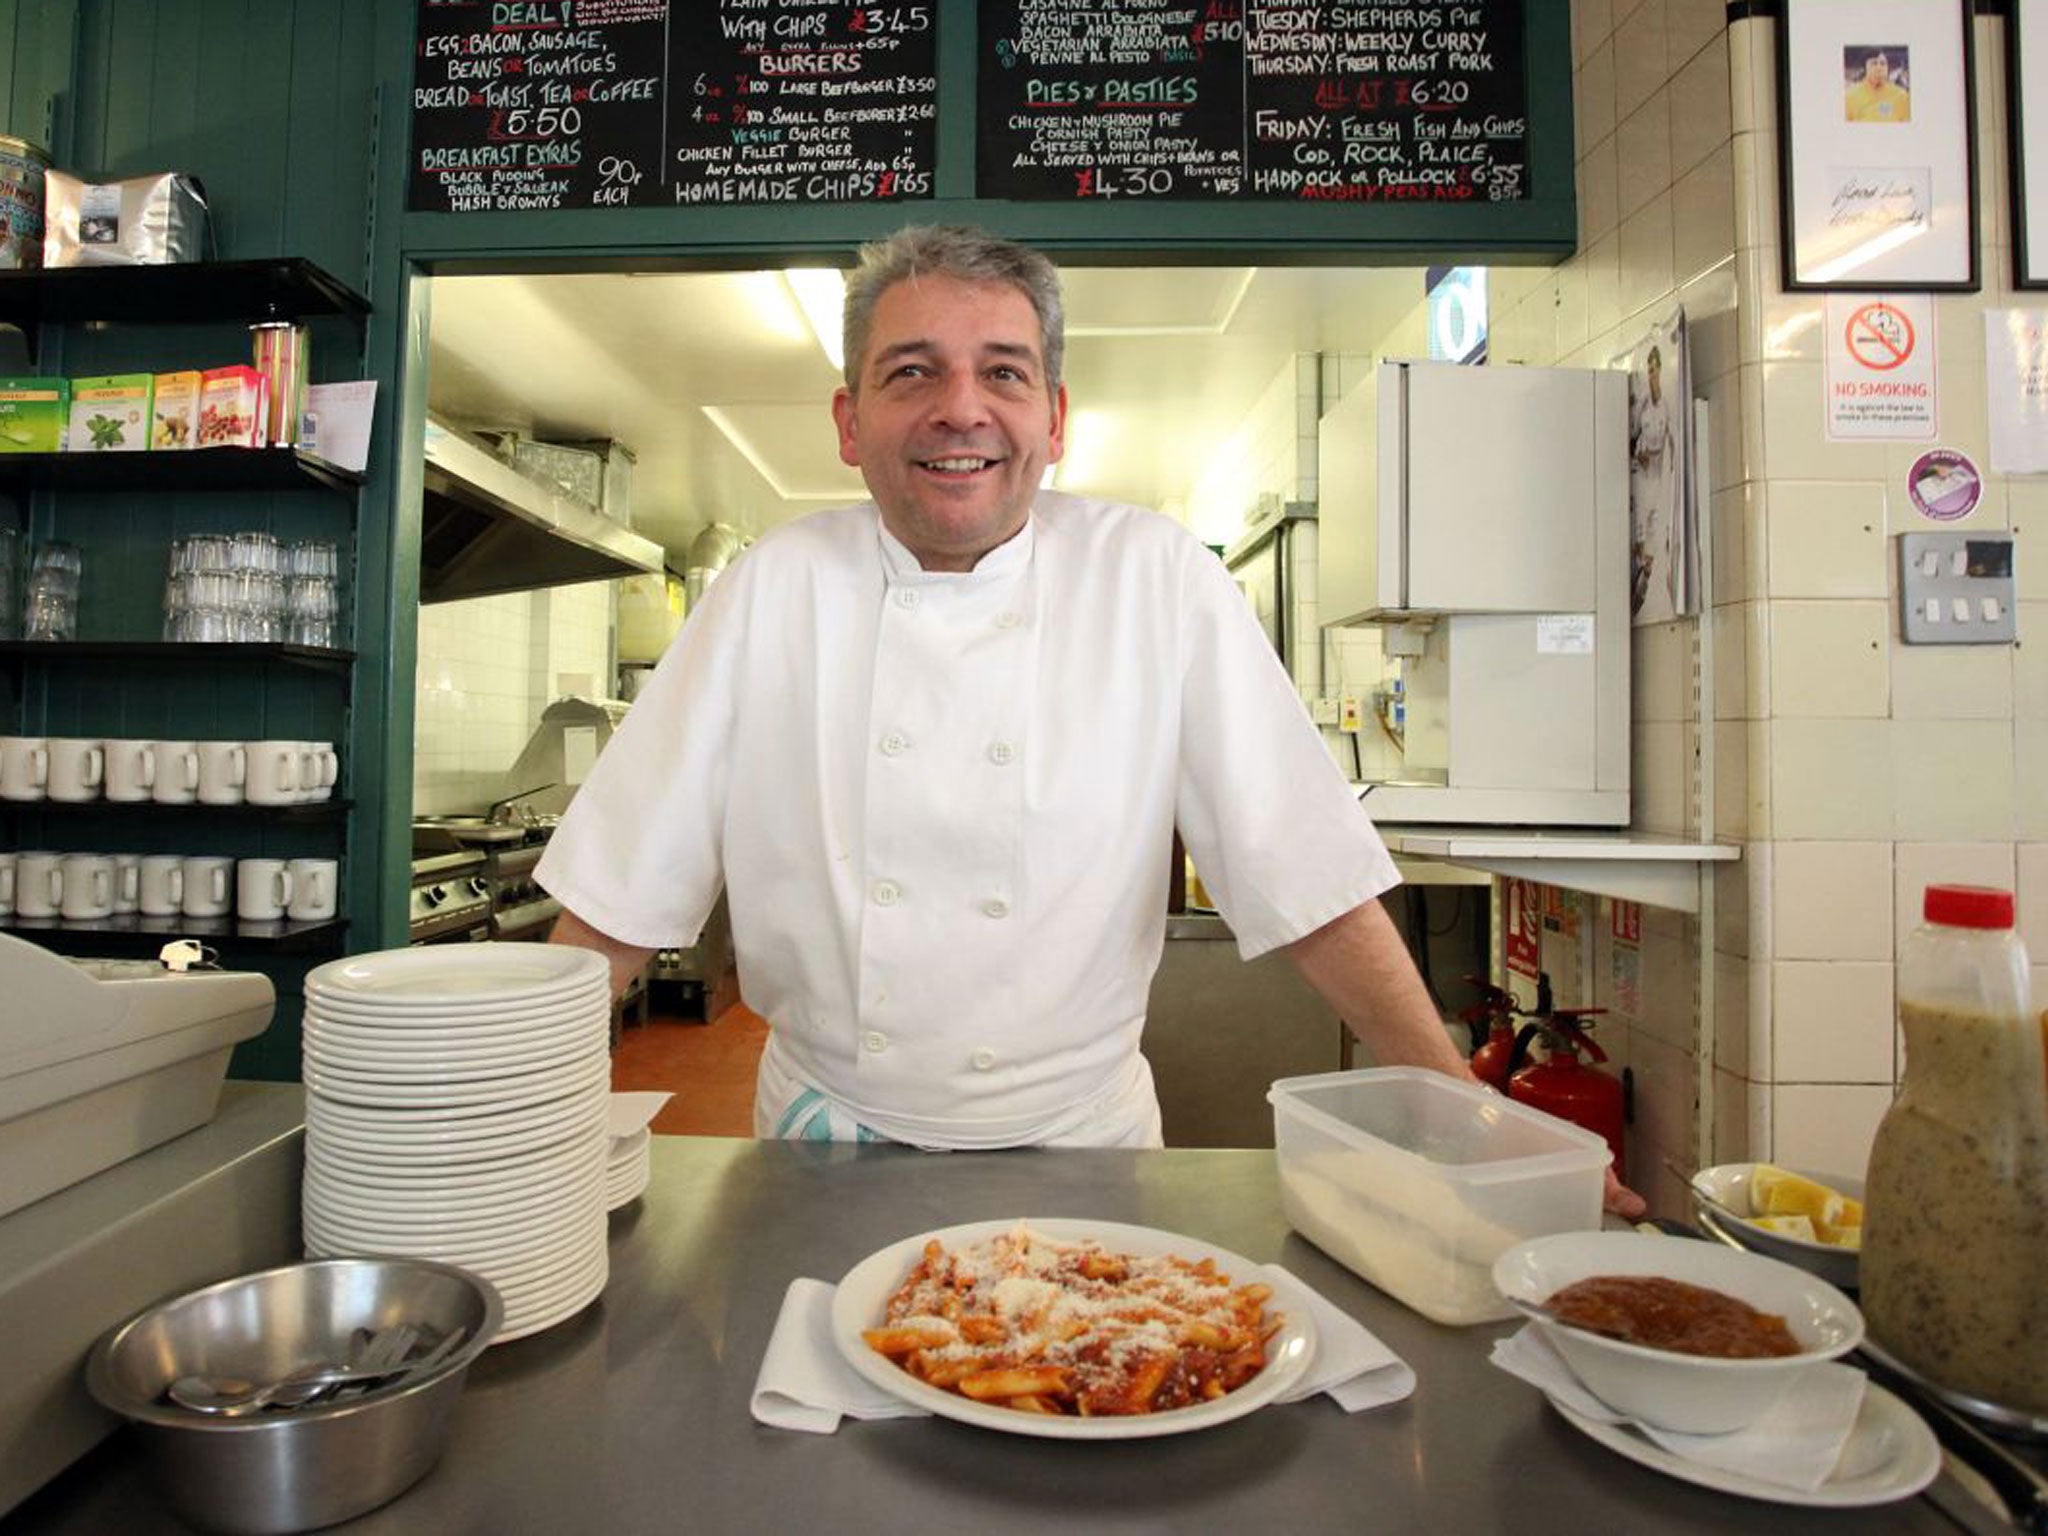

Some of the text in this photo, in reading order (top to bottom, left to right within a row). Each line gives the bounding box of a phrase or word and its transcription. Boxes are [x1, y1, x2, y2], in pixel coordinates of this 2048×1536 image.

[720, 14, 767, 41] WITH
[773, 12, 827, 37] CHIPS
[1020, 10, 1108, 26] SPAGHETTI
[1248, 7, 1482, 31] TUESDAY: SHEPHERDS PIE
[1021, 26, 1072, 41] BACON
[1246, 29, 1487, 54] WEDNESDAY: WEEKLY CURRY
[1010, 38, 1100, 55] VEGETARIAN
[447, 57, 502, 80] BEANS
[523, 52, 617, 77] TOMATOES
[759, 52, 862, 75] BURGERS
[1029, 51, 1083, 65] PENNE
[1089, 51, 1107, 64] AL
[1109, 50, 1151, 64] PESTO
[1247, 52, 1494, 75] THURSDAY: FRESH ROAST PORK
[414, 85, 470, 109] BREAD
[539, 79, 571, 105] TEA
[588, 76, 659, 102] COFFEE
[1026, 79, 1081, 104] PIES
[1104, 76, 1199, 104] PASTIES
[767, 106, 819, 124] SMALL
[1008, 115, 1072, 130] CHICKEN
[1158, 111, 1183, 128] PIE
[1255, 109, 1526, 141] FRIDAY: FRESH FISH AND CHIPS
[731, 127, 782, 145] VEGGIE
[788, 125, 852, 142] BURGER
[1035, 126, 1151, 141] CORNISH PASTY
[422, 138, 582, 169] BREAKFAST EXTRAS
[677, 145, 732, 162] CHICKEN
[741, 143, 789, 160] FILLET
[798, 143, 853, 158] BURGER
[1029, 140, 1089, 153] CHEESE
[1108, 140, 1151, 152] ONION
[1153, 137, 1199, 153] PASTY
[1293, 140, 1494, 168] COD, ROCK, PLAICE,
[734, 160, 784, 175] BURGER
[1012, 152, 1038, 168] ALL
[1042, 152, 1096, 167] SERVED
[1097, 151, 1131, 166] WITH
[1133, 152, 1167, 166] CHIPS
[1221, 149, 1240, 161] OR
[440, 167, 545, 185] BLACK PUDDING
[1184, 163, 1242, 177] POTATOES
[1254, 167, 1343, 193] HADDOCK
[1350, 170, 1369, 183] OR
[1378, 166, 1457, 187] POLLOCK
[447, 183, 501, 197] BUBBLE
[513, 179, 569, 196] SQUEAK
[592, 185, 630, 206] EACH
[675, 176, 801, 204] HOMEMADE
[806, 172, 876, 200] CHIPS
[451, 192, 560, 212] HASH BROWNS
[1835, 382, 1928, 398] NO SMOKING
